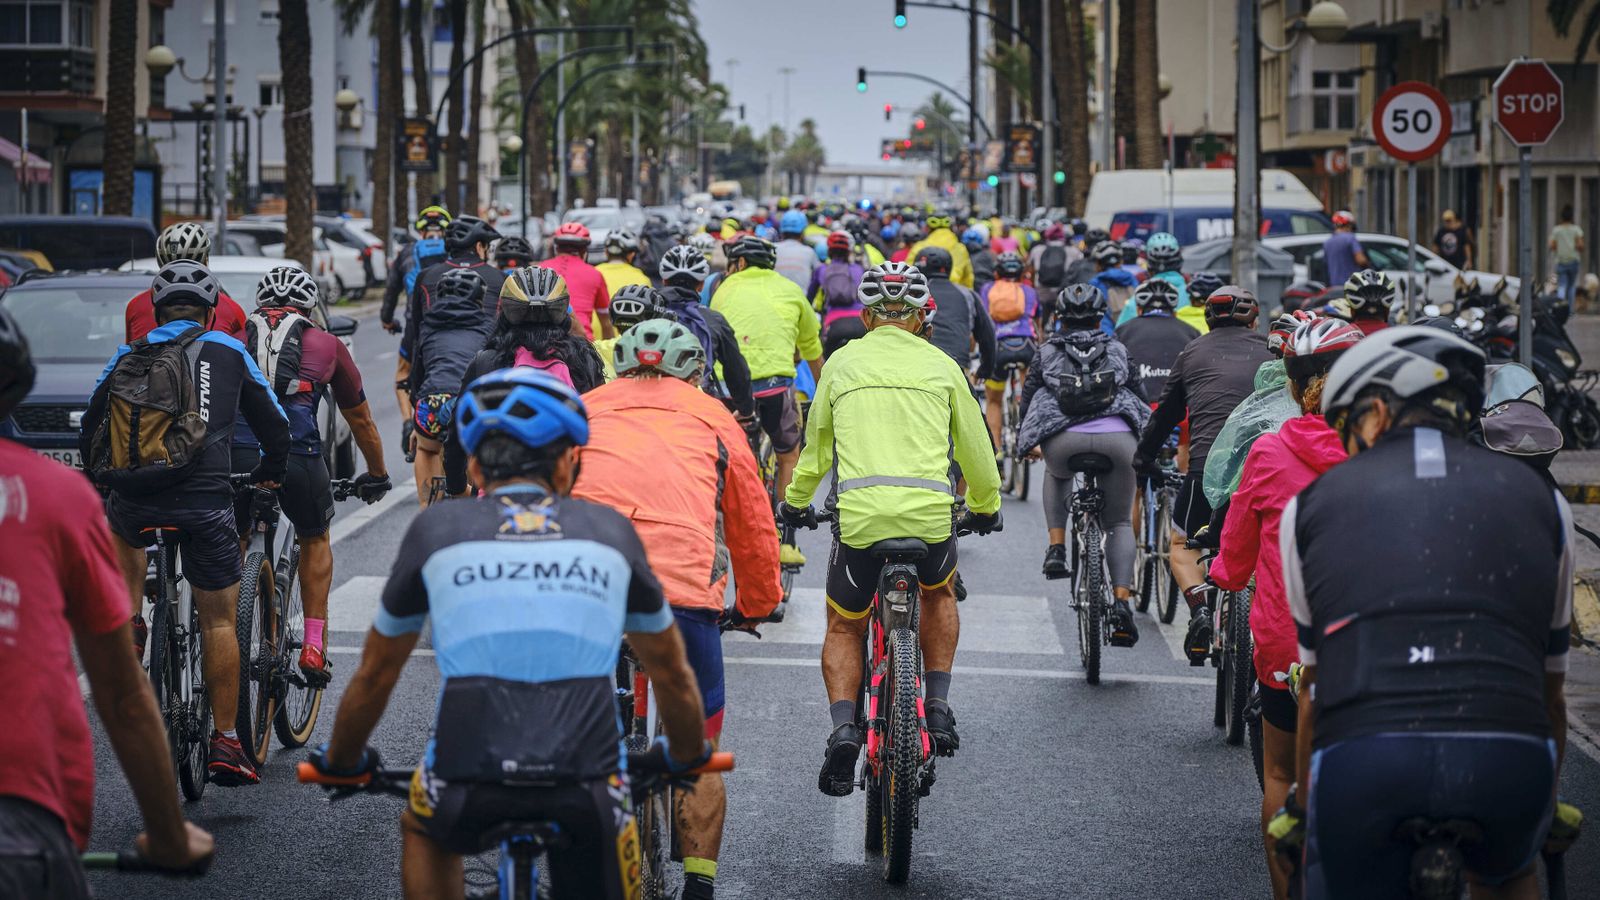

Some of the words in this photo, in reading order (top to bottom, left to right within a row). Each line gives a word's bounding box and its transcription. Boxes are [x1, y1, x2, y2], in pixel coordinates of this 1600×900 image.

[1502, 94, 1558, 114] STOP
[1391, 109, 1432, 134] 50
[453, 557, 610, 588] GUZMÁN
